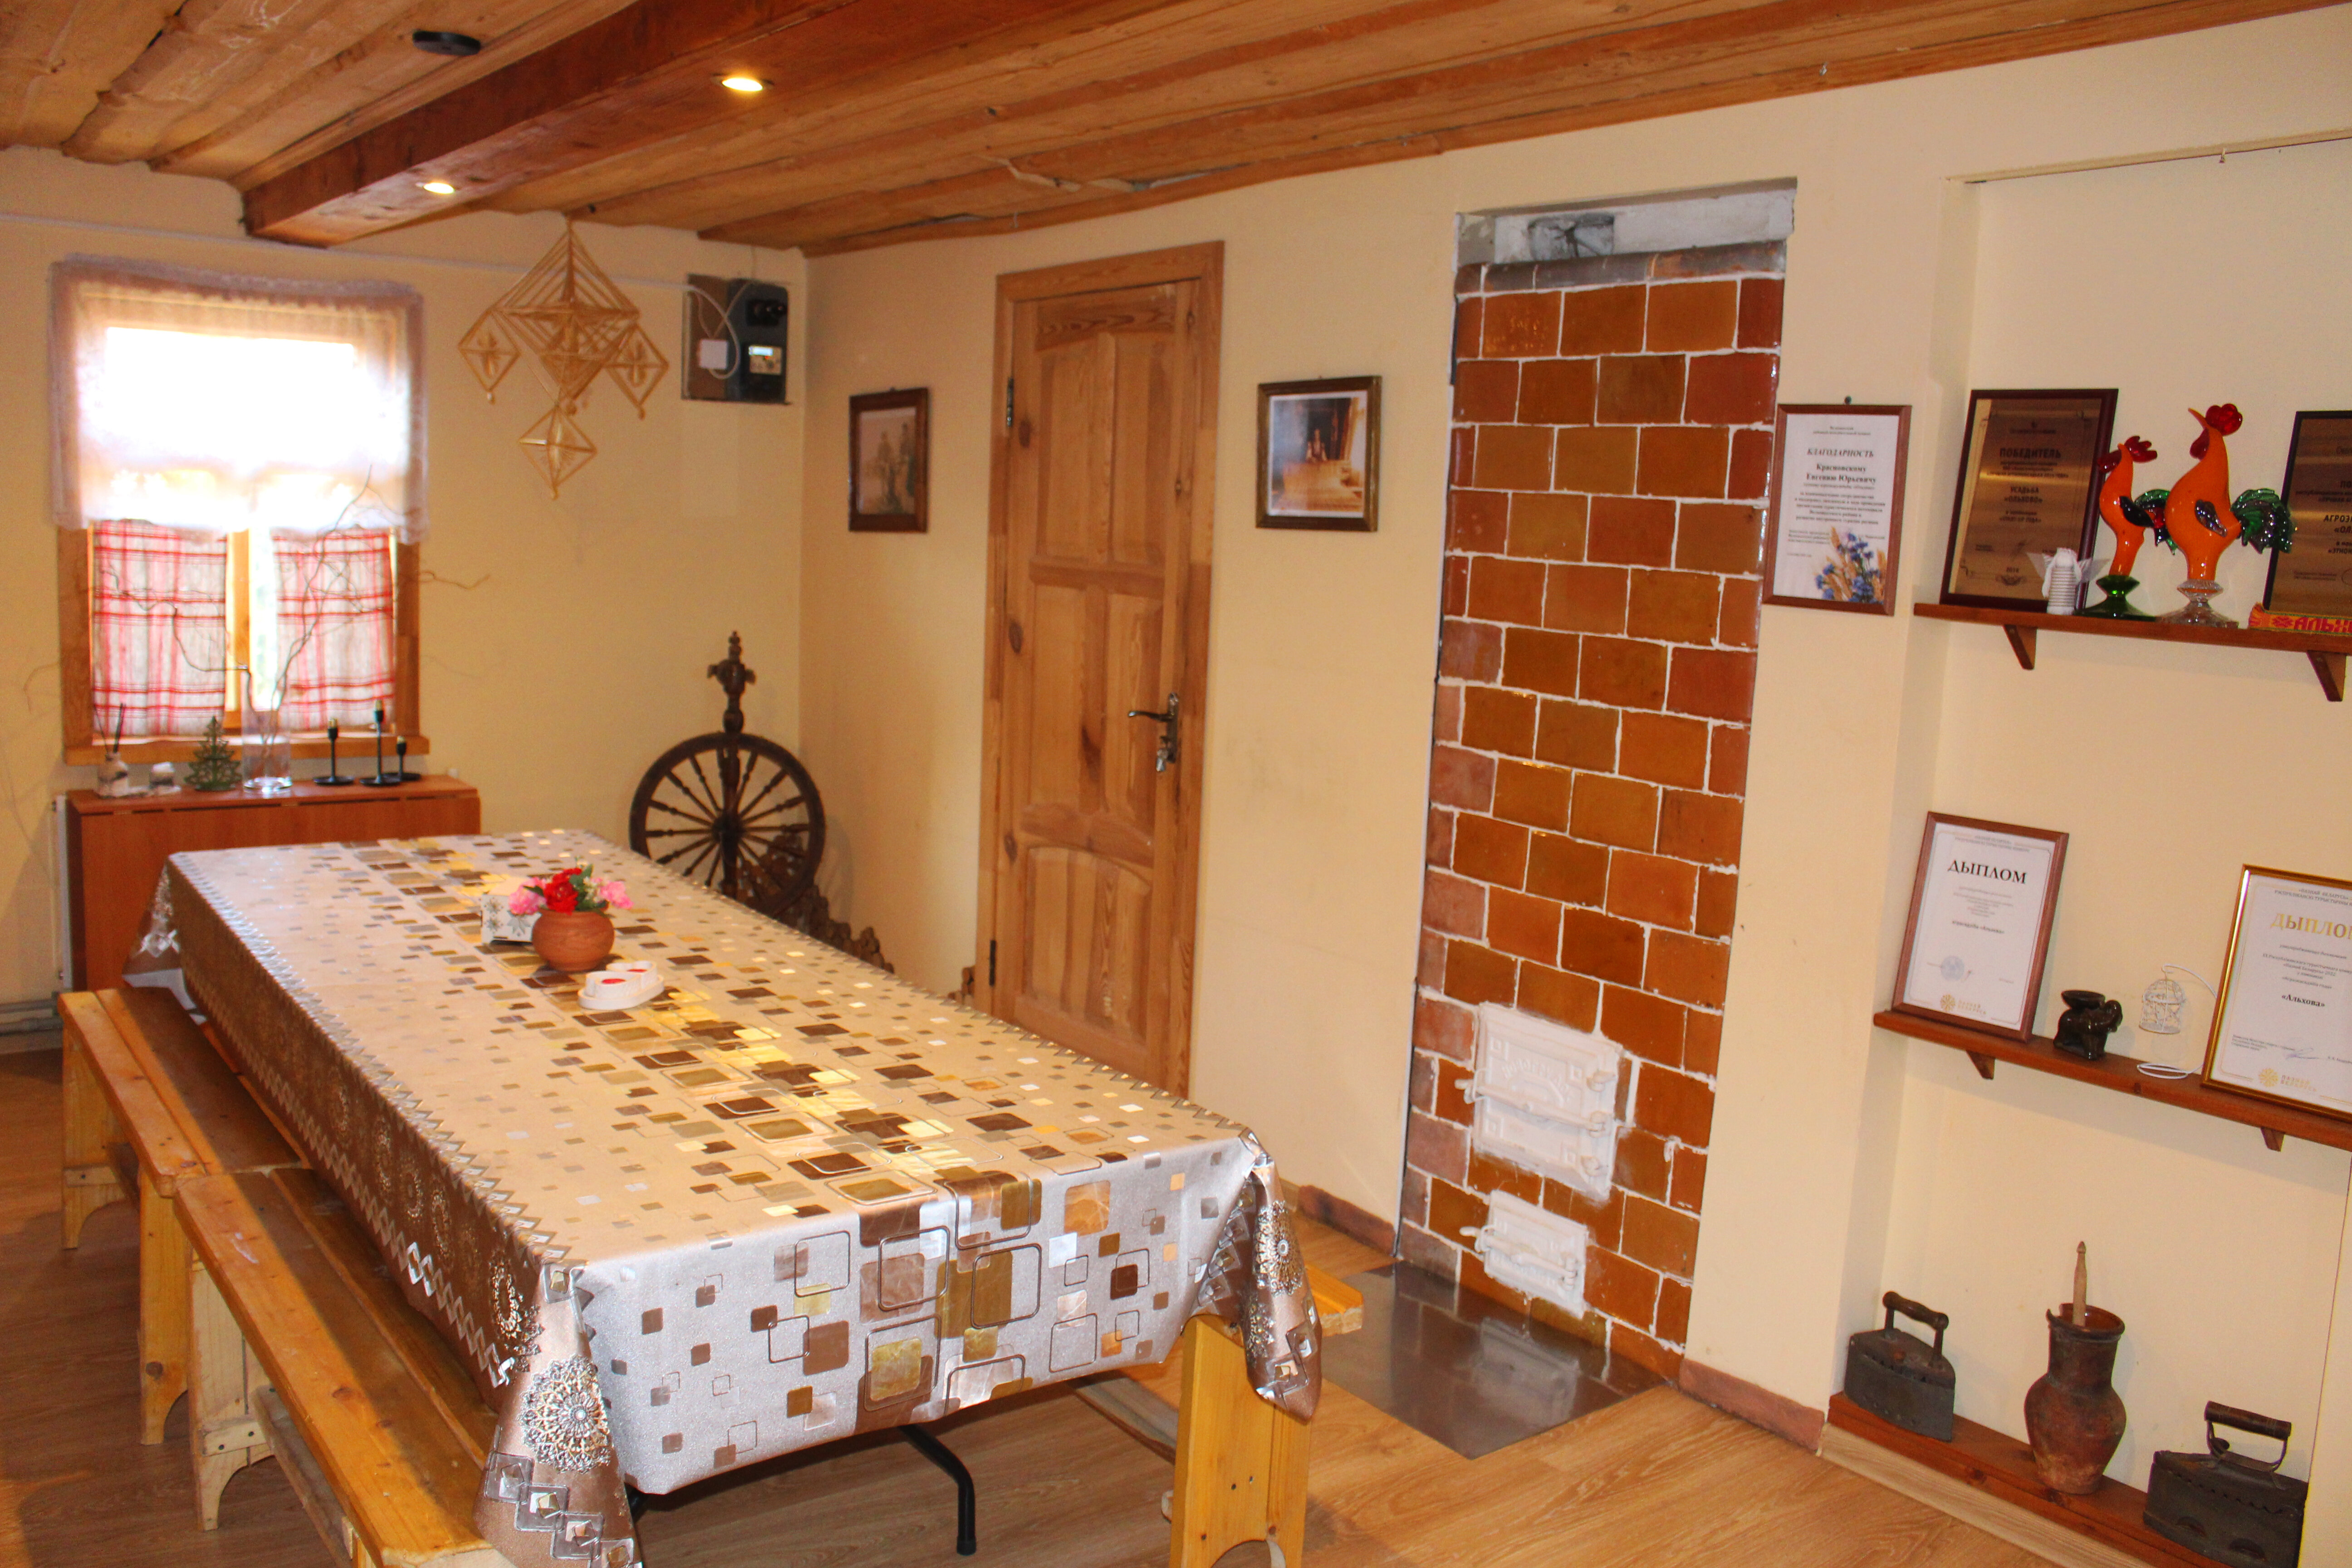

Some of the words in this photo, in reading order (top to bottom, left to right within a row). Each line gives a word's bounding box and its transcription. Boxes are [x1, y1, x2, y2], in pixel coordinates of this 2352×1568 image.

[2000, 447, 2061, 459] ПОБЕДИТЕЛЬ
[2334, 526, 2352, 534] «ОЛ
[2294, 617, 2352, 633] АЛЬХ
[1947, 860, 2027, 884] ДЫПЛОМ
[2270, 913, 2352, 940] ДЫПЛО
[2282, 994, 2325, 1007] «Альхова»
